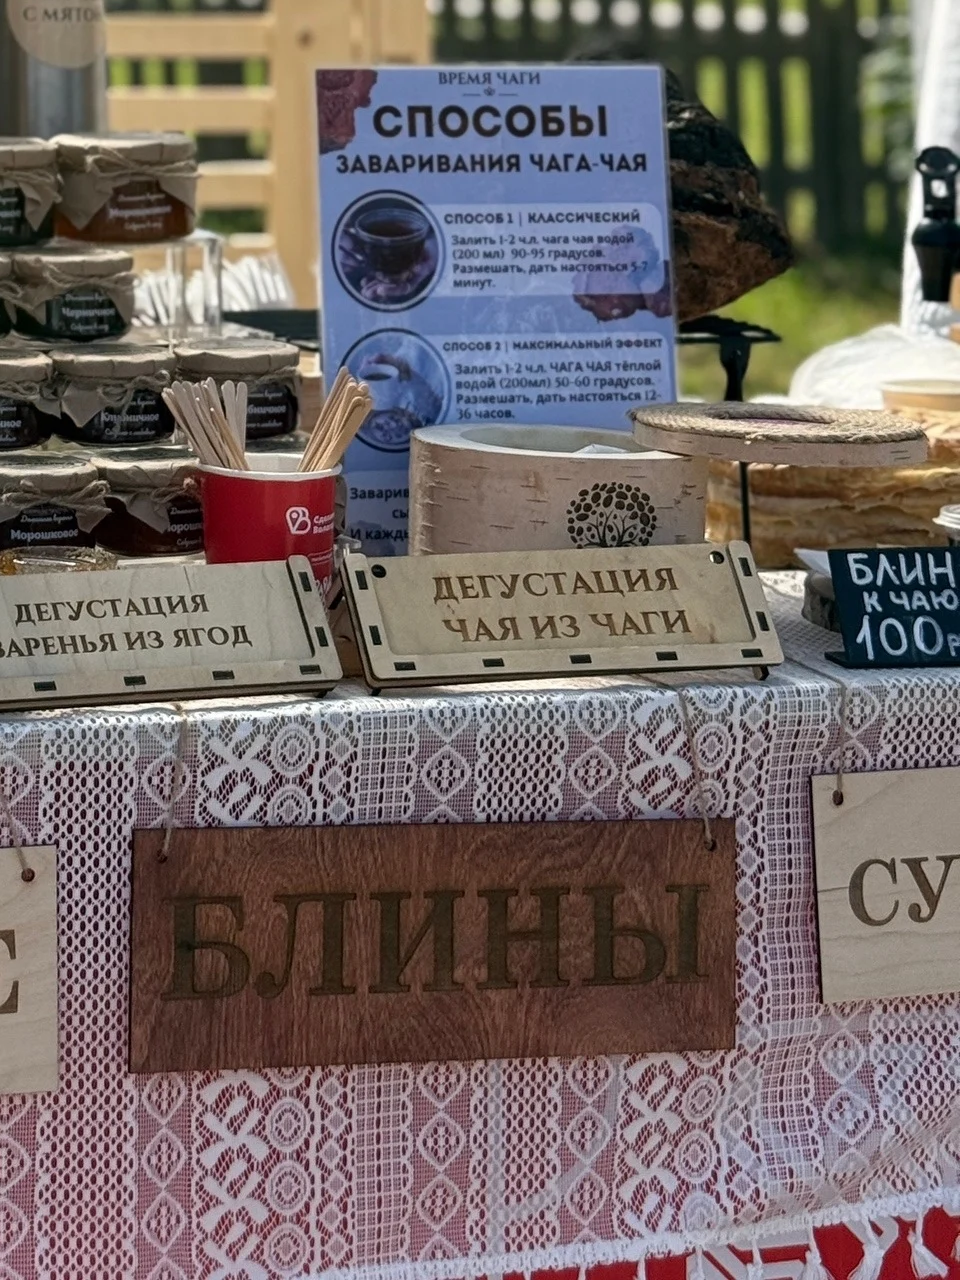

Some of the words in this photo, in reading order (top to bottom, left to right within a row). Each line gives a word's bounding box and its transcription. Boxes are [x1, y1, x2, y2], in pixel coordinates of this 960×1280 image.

[22, 6, 37, 22] С
[438, 71, 492, 85] ВРЕМЯ
[497, 71, 541, 85] ЧАГИ
[372, 104, 608, 138] СПОСОБЫ
[336, 154, 521, 174] ЗАВАРИВАНИЯ
[529, 153, 647, 173] ЧАГА-ЧАЯ
[443, 213, 503, 225] СПОСОБ
[506, 213, 514, 224] 1
[527, 209, 641, 224] КЛАССИЧЕСКИЙ
[451, 235, 496, 246] Залить
[499, 235, 516, 246] 1-2
[542, 236, 570, 245] чага
[573, 236, 594, 245] чая
[597, 233, 635, 246] водой
[452, 249, 480, 261] (200
[482, 249, 505, 261] мл)
[511, 248, 545, 260] 90-95
[548, 250, 606, 262] градусов.
[453, 263, 526, 275] Размешать,
[528, 264, 557, 275] дать
[560, 262, 628, 273] настояться
[630, 261, 649, 273] 5-7
[453, 279, 496, 291] минут.
[443, 341, 492, 352] СПОСОБ
[512, 337, 613, 351] МАКСИМАЛЬНЫЙ
[615, 338, 663, 349] ЭФФЕКТ
[454, 363, 502, 376] Залить
[504, 363, 522, 374] 1-2
[549, 361, 584, 372] ЧАГА
[585, 361, 612, 372] ЧАЯ
[614, 359, 662, 371] тёплой
[455, 376, 496, 390] водой
[499, 376, 551, 389] (200мл)
[554, 376, 590, 388] 50-60
[593, 376, 655, 389] градусов.
[456, 393, 533, 405] Размешать,
[536, 392, 566, 406] дать
[569, 391, 641, 403] настояться
[456, 408, 471, 420] 36
[475, 409, 515, 420] часов.
[10, 527, 79, 543] Морошковое
[350, 528, 361, 540] И
[433, 566, 680, 604] ДЕГУСТАЦИЯ
[889, 588, 959, 611] ЧАЮ
[14, 594, 210, 627] ДЕГУСТАЦИЯ
[442, 616, 522, 644] ЧАЯ
[532, 614, 580, 639] ИЗ
[589, 609, 693, 637] ЧАГИ
[123, 630, 165, 652] ИЗ
[172, 625, 253, 650] ЯГОД
[848, 854, 960, 927] СУ
[161, 883, 710, 1001] БЛИНЫ
